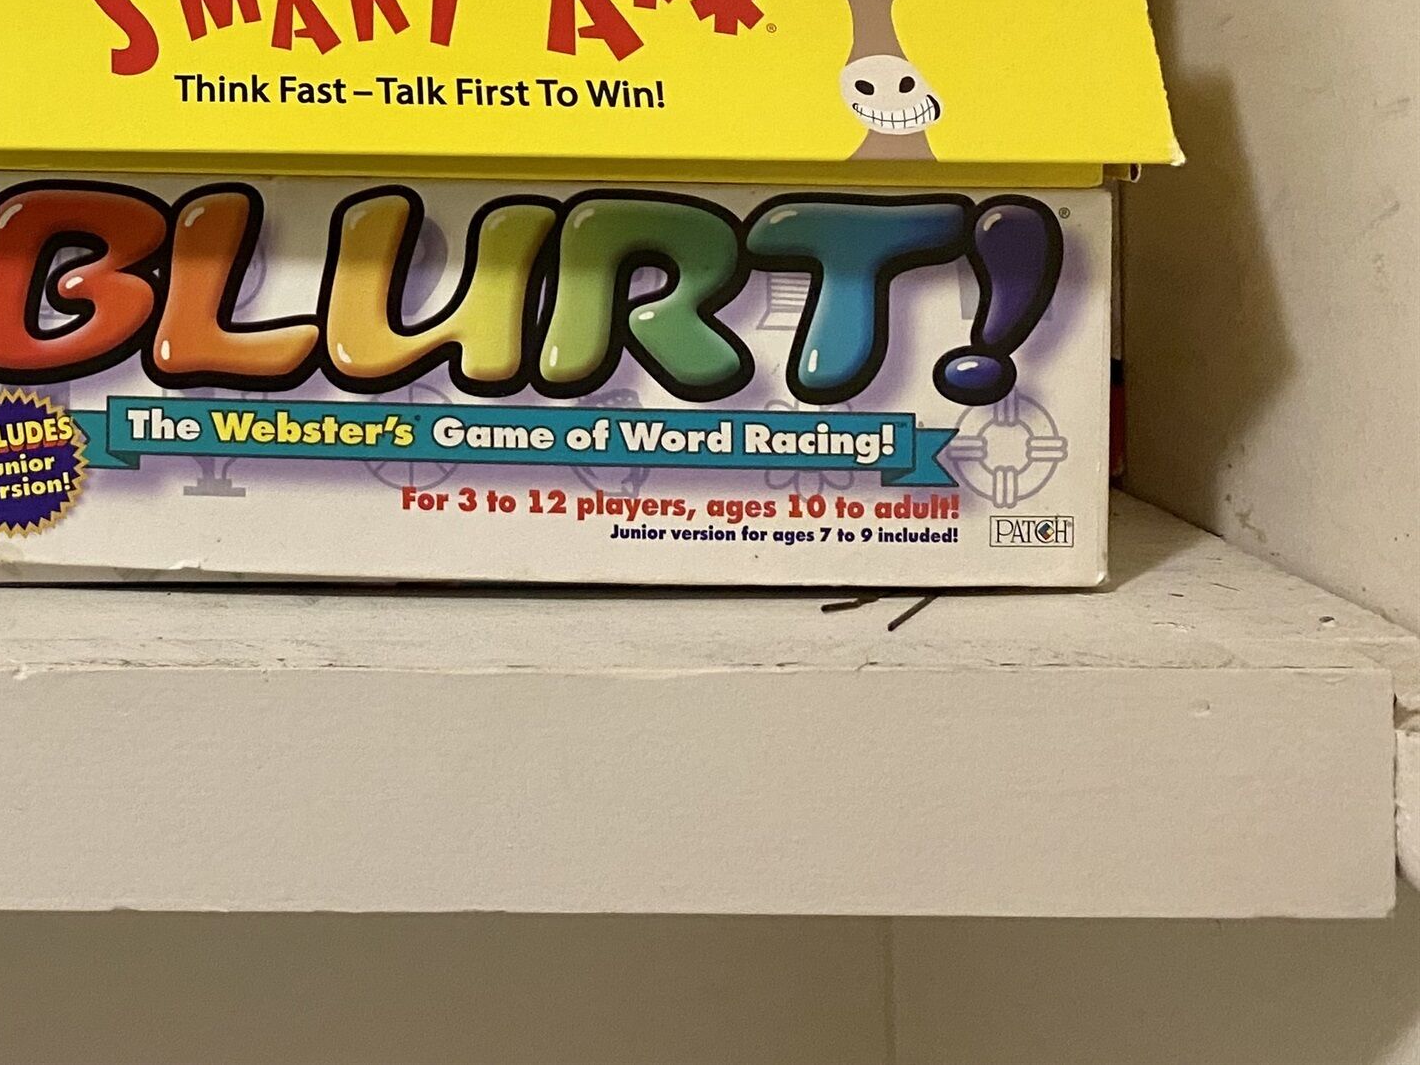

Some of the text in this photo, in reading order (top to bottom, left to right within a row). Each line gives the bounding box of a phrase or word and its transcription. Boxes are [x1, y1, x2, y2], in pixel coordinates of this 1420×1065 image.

[174, 74, 271, 103] Think
[456, 78, 530, 107] First
[536, 79, 578, 107] To
[585, 80, 666, 108] Win!
[126, 408, 896, 465] The Webster's Game of Word Racing!
[401, 486, 960, 524] For 3 to 12 players, ages 10 to adult!
[610, 524, 959, 547] Junior version for ages 7 to 9 included!
[995, 519, 1069, 543] PATCH
